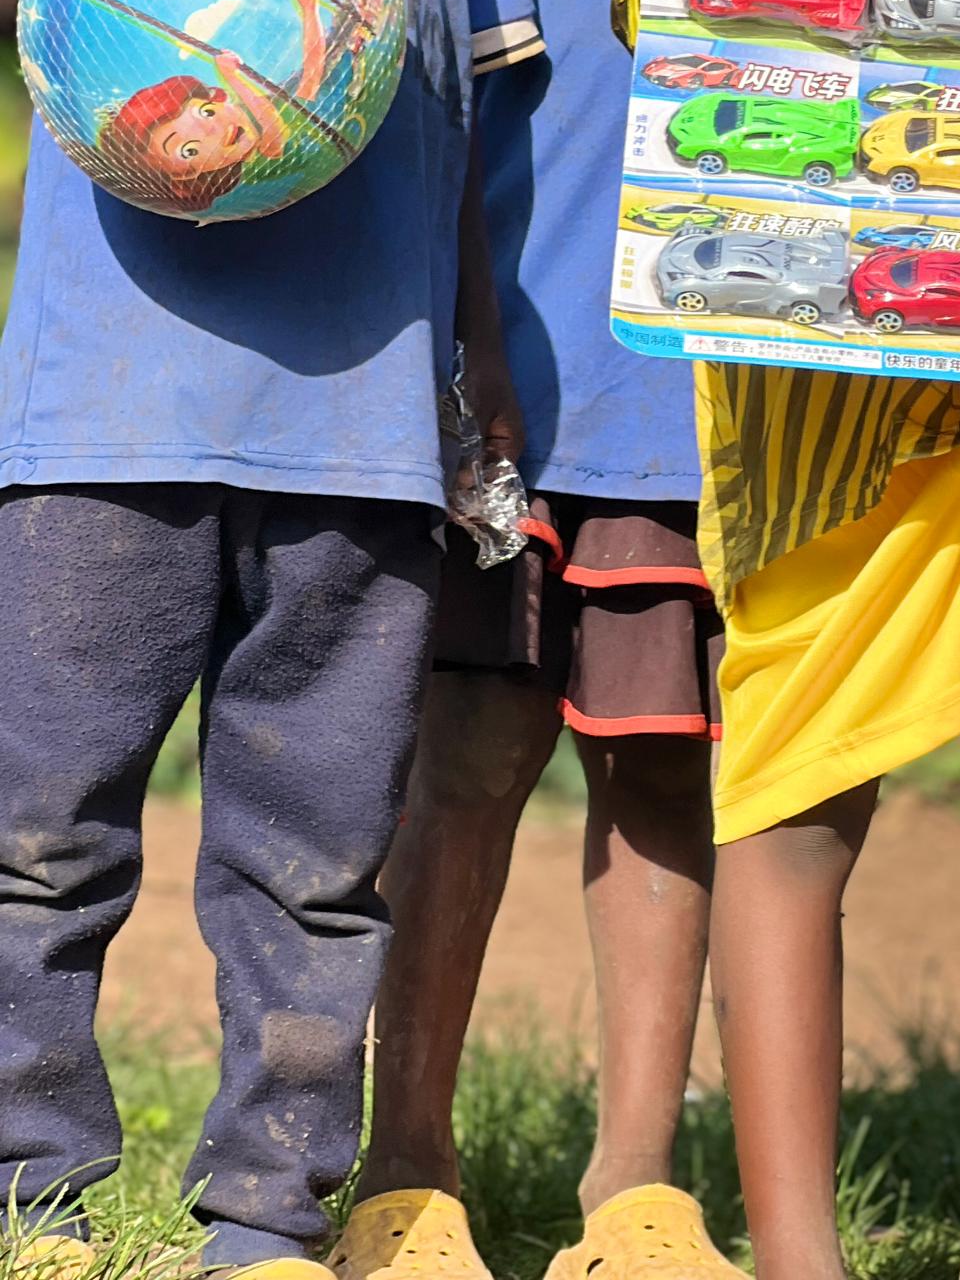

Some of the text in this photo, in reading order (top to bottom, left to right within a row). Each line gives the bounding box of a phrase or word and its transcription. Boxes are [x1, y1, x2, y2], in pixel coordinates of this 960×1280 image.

[737, 63, 853, 100] 闪电飞车
[620, 327, 683, 349] 中国制造
